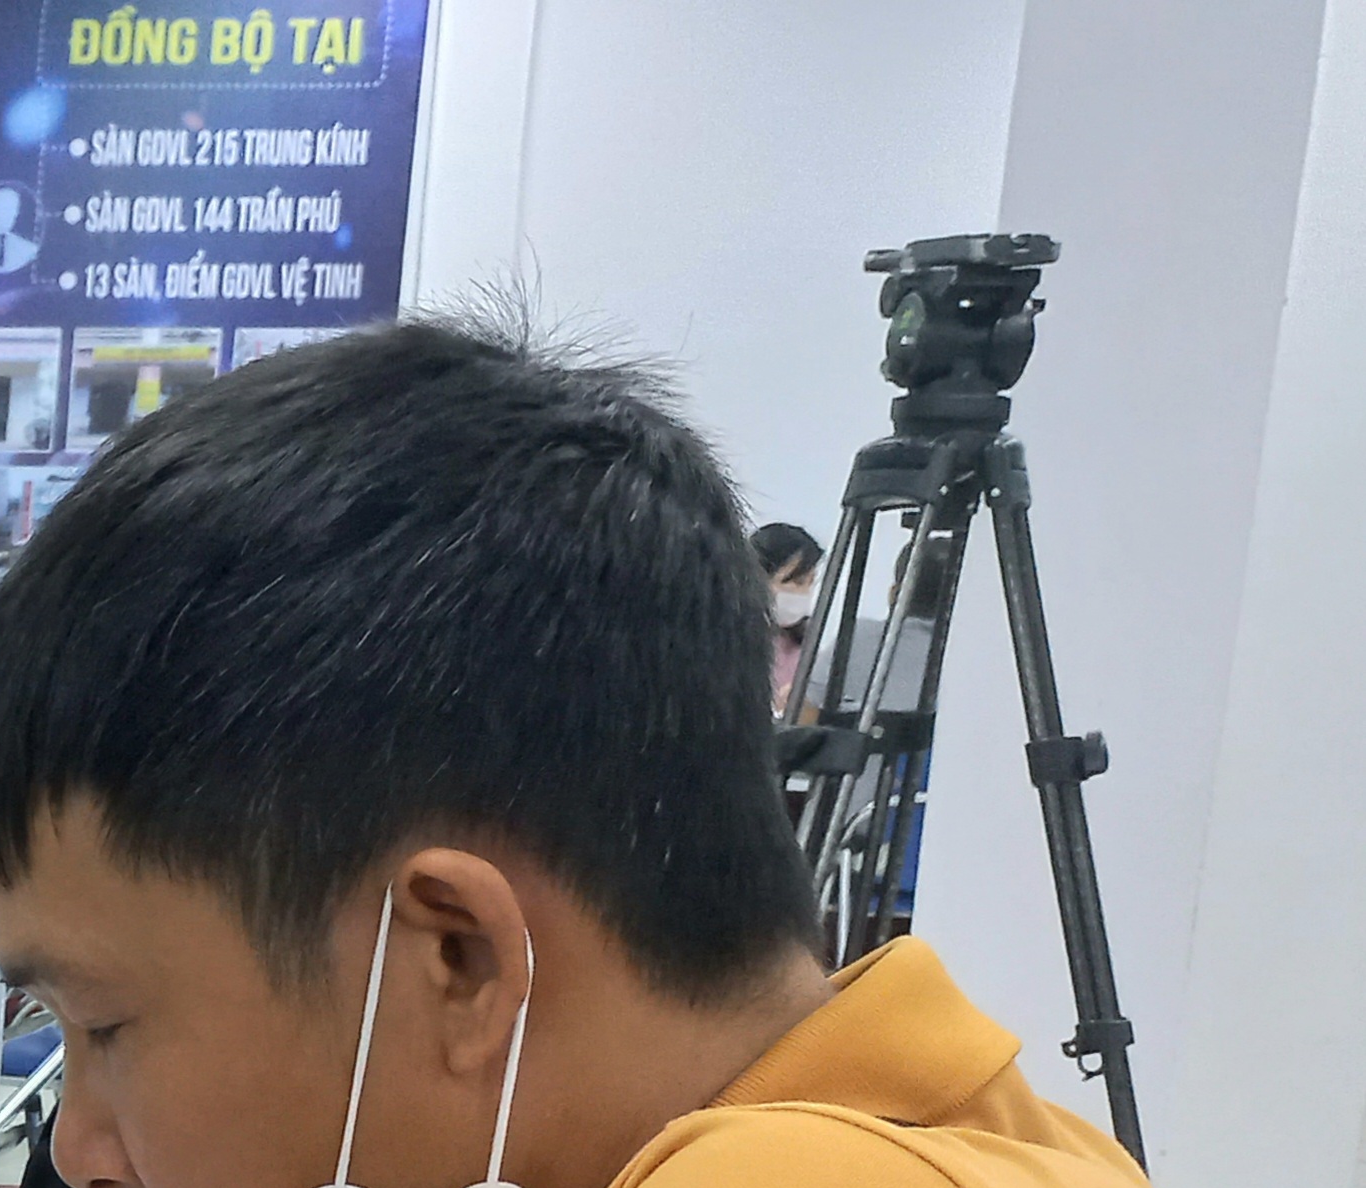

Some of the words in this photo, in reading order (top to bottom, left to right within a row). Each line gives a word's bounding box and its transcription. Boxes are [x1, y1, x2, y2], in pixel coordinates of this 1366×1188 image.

[69, 5, 200, 66] ĐỒNG
[211, 9, 275, 73] BỘ
[289, 17, 364, 74] TẠI
[90, 124, 134, 166] SÀN
[138, 130, 192, 166] GDVL
[196, 130, 240, 166] 215
[243, 129, 312, 166] TRUNG
[315, 121, 368, 166] KÍNH
[85, 190, 131, 233] SÀN
[134, 197, 188, 233] GDVL
[193, 196, 234, 233] 144
[295, 189, 341, 233] PHÚ
[84, 264, 109, 299] 13
[164, 249, 220, 300] ĐIỂM
[222, 264, 276, 299] GDVL
[313, 263, 363, 299] TINH
